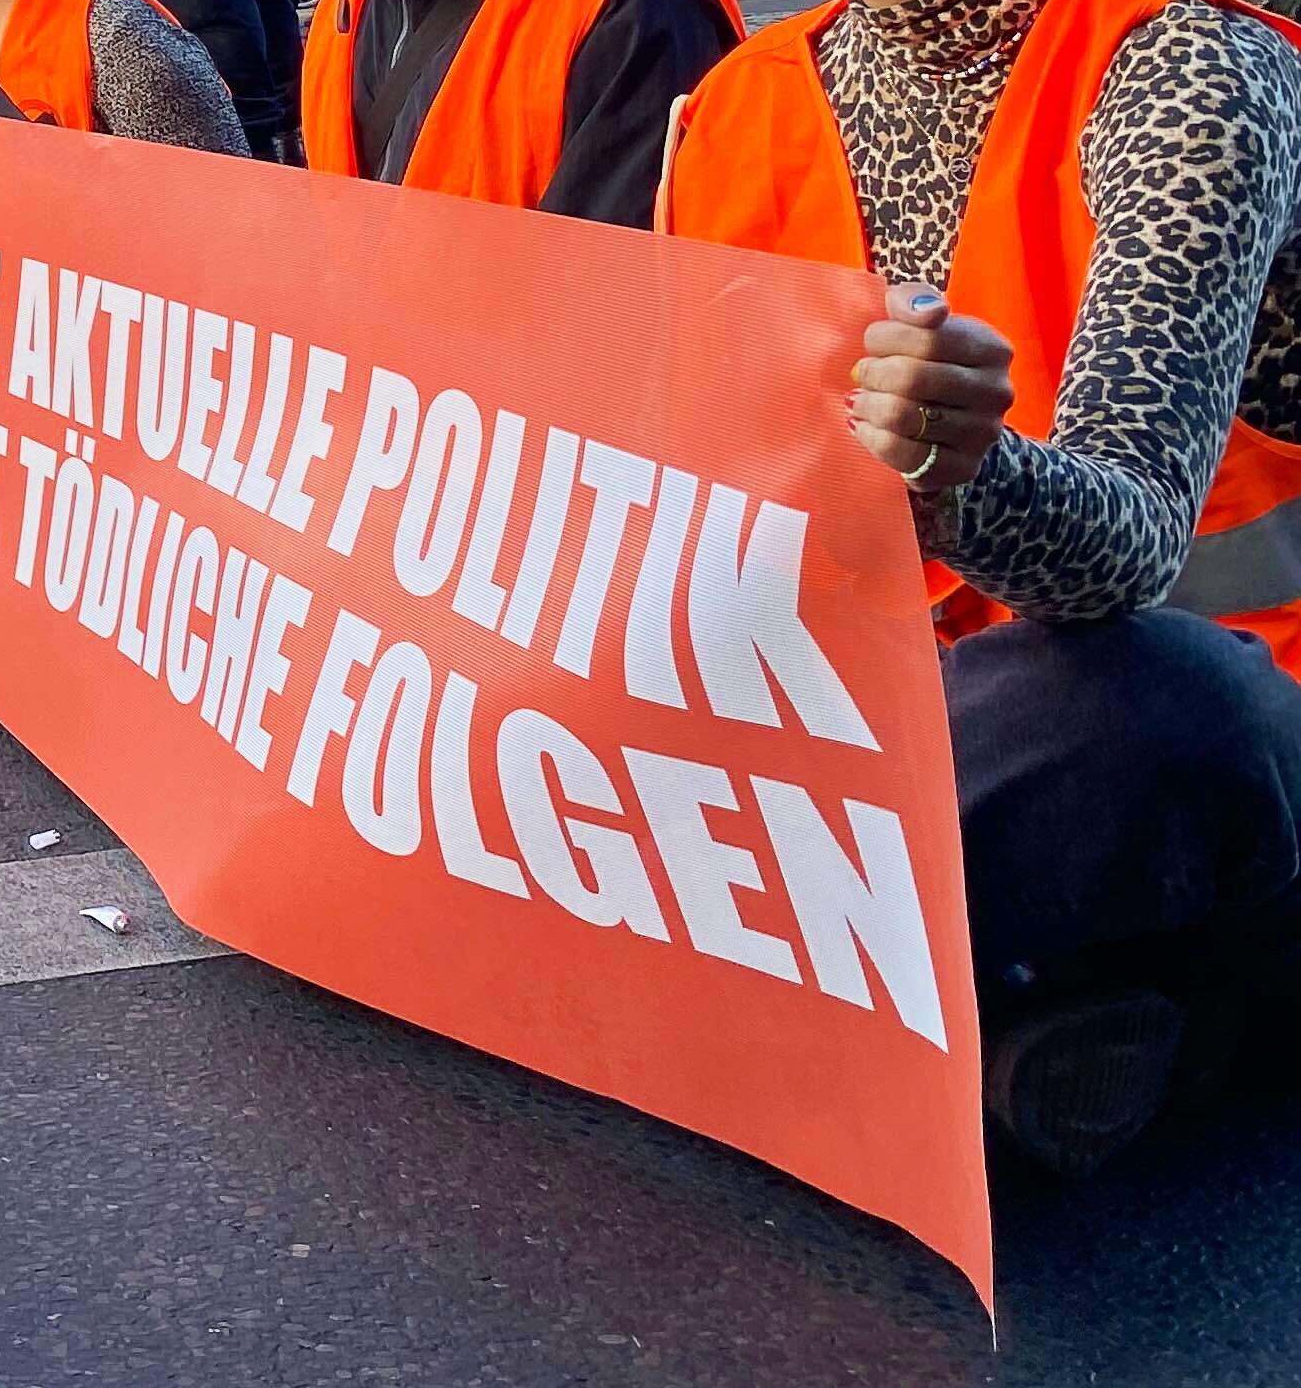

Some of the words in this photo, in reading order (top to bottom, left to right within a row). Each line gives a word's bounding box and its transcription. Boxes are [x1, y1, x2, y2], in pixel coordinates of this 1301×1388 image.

[8, 258, 347, 533] AKTUELLE
[326, 362, 885, 754] POLITIK
[13, 417, 312, 774] TÖDLICHE
[286, 611, 950, 1055] FOLGEN
